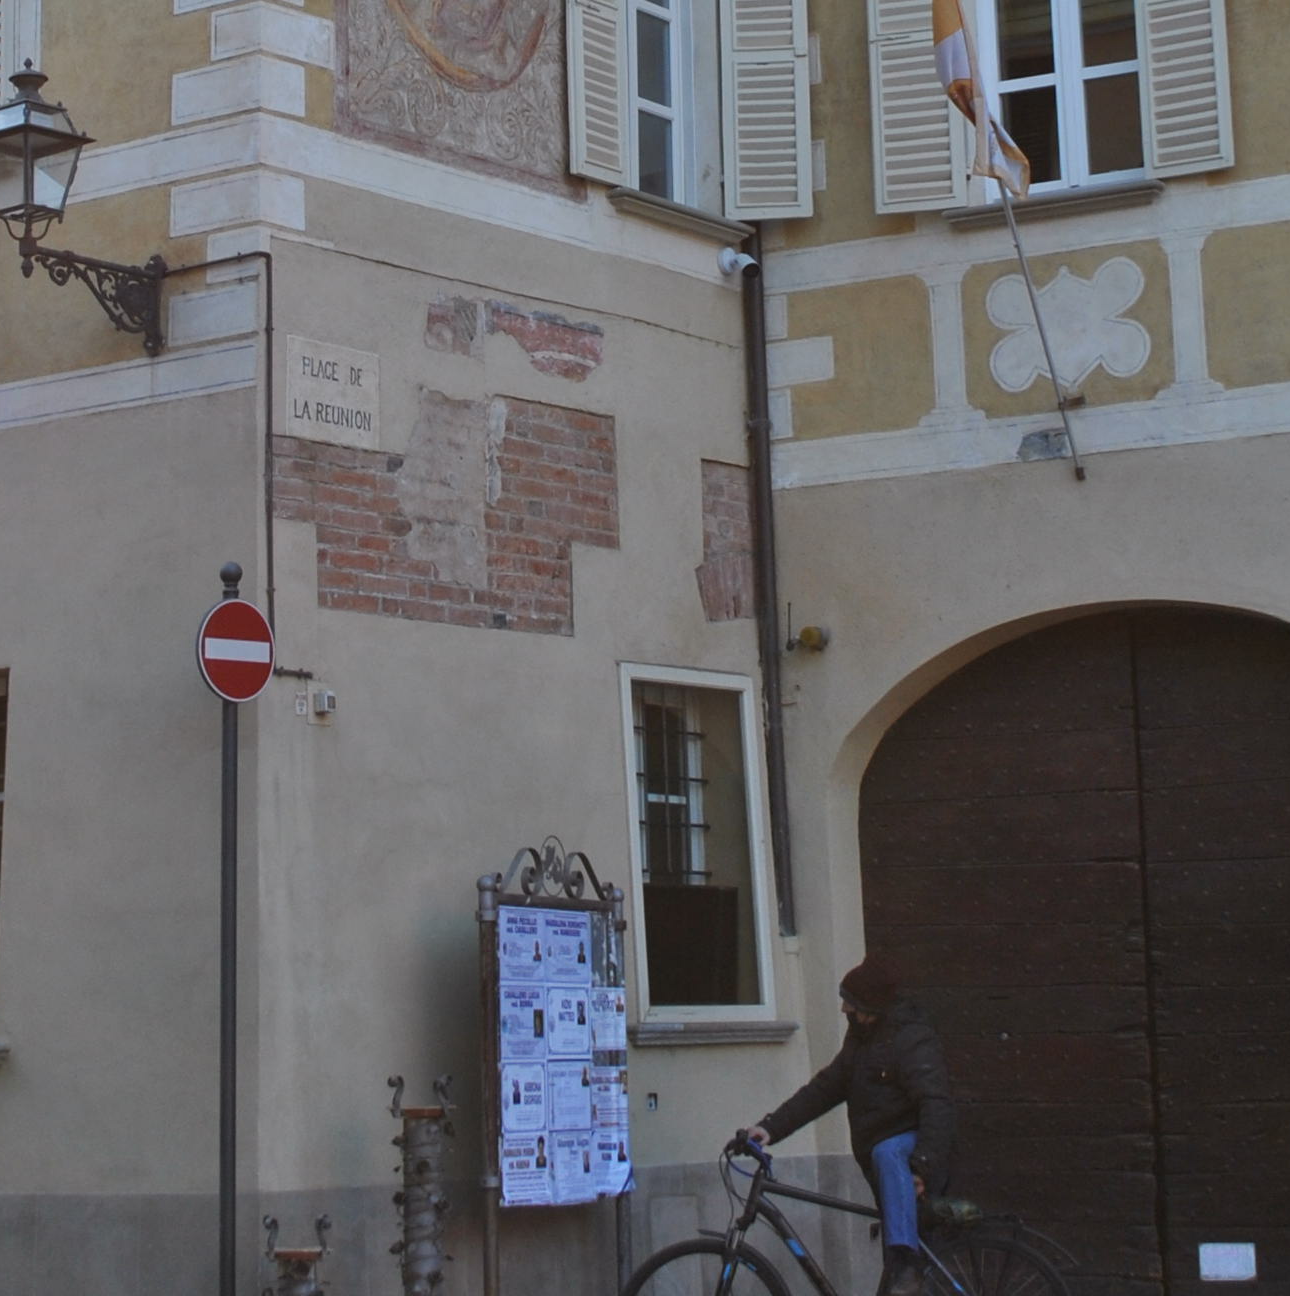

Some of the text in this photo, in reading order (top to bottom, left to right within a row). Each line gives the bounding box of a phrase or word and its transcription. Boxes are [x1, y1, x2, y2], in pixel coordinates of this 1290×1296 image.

[302, 356, 363, 387] PLACE DE
[293, 398, 311, 421] LA
